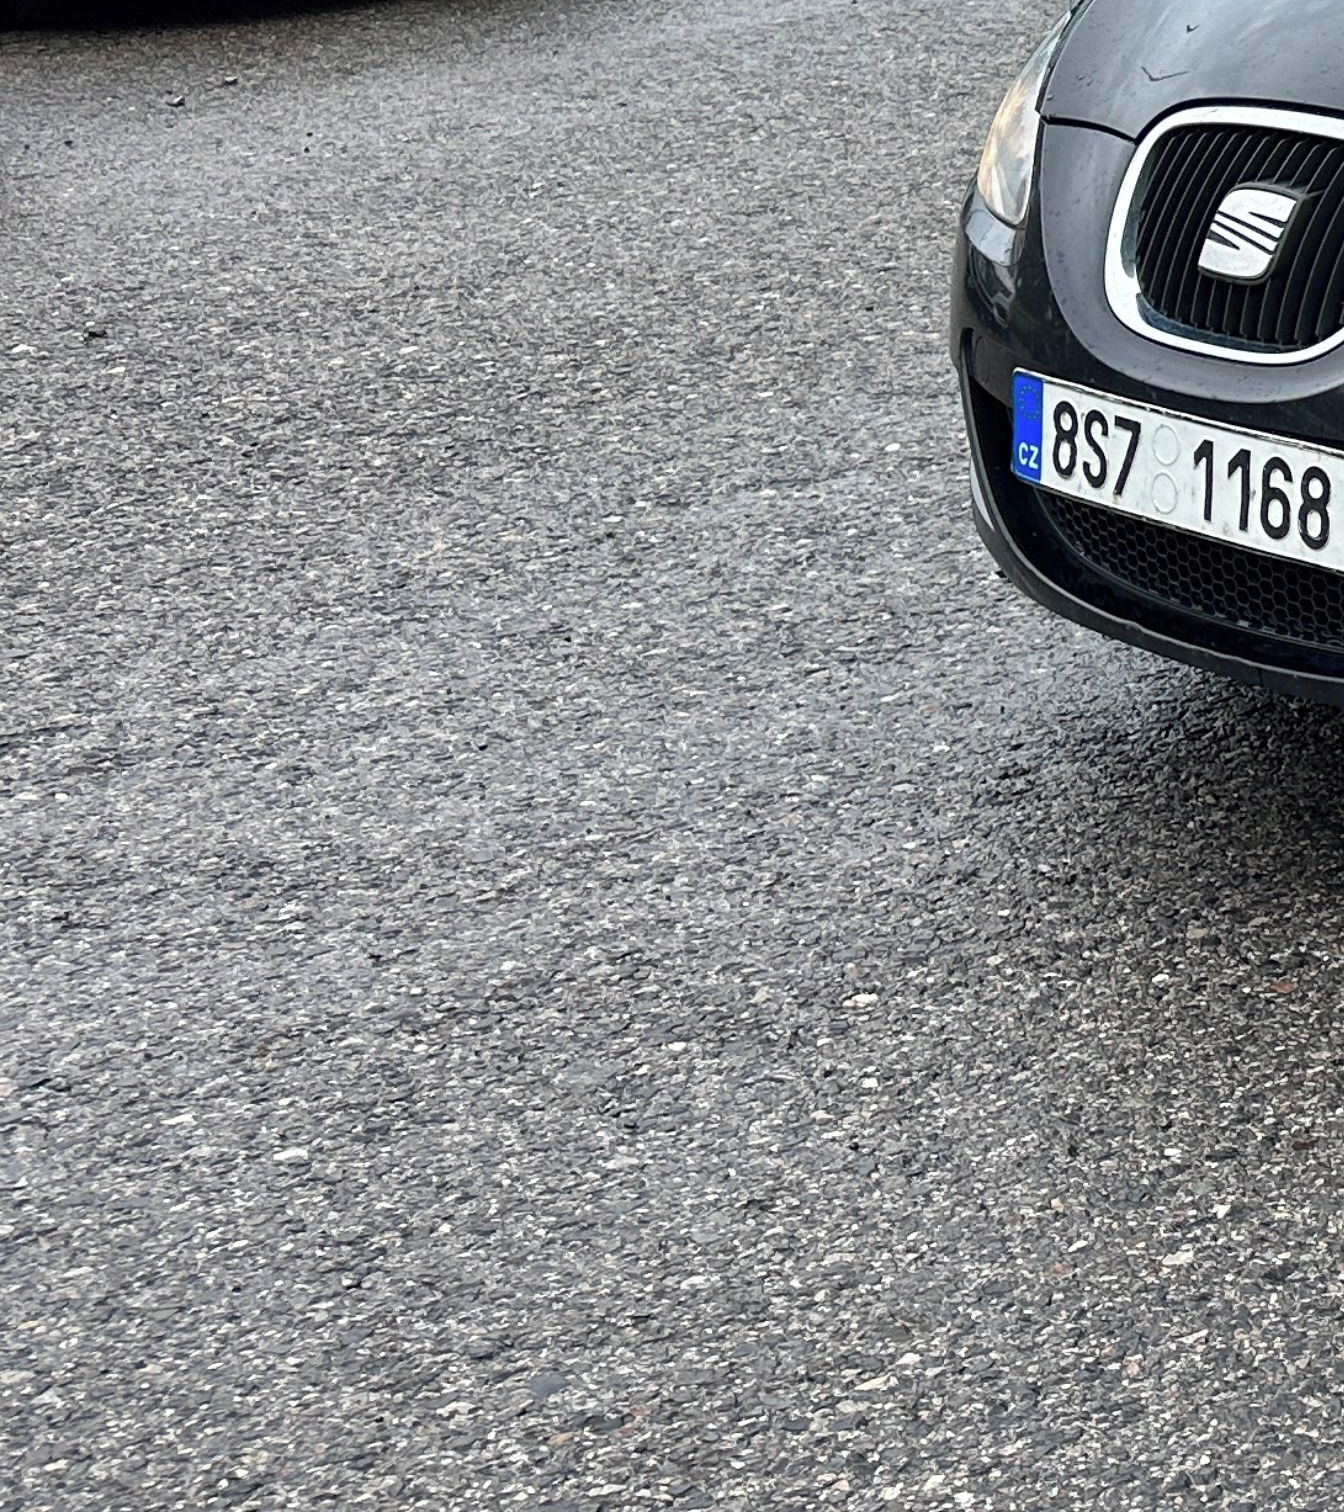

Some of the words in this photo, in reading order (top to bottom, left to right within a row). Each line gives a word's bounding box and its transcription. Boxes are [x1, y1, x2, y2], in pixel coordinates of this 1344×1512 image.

[1017, 442, 1039, 470] CZ
[1052, 400, 1142, 497] 8S7
[1193, 439, 1332, 550] 1168
